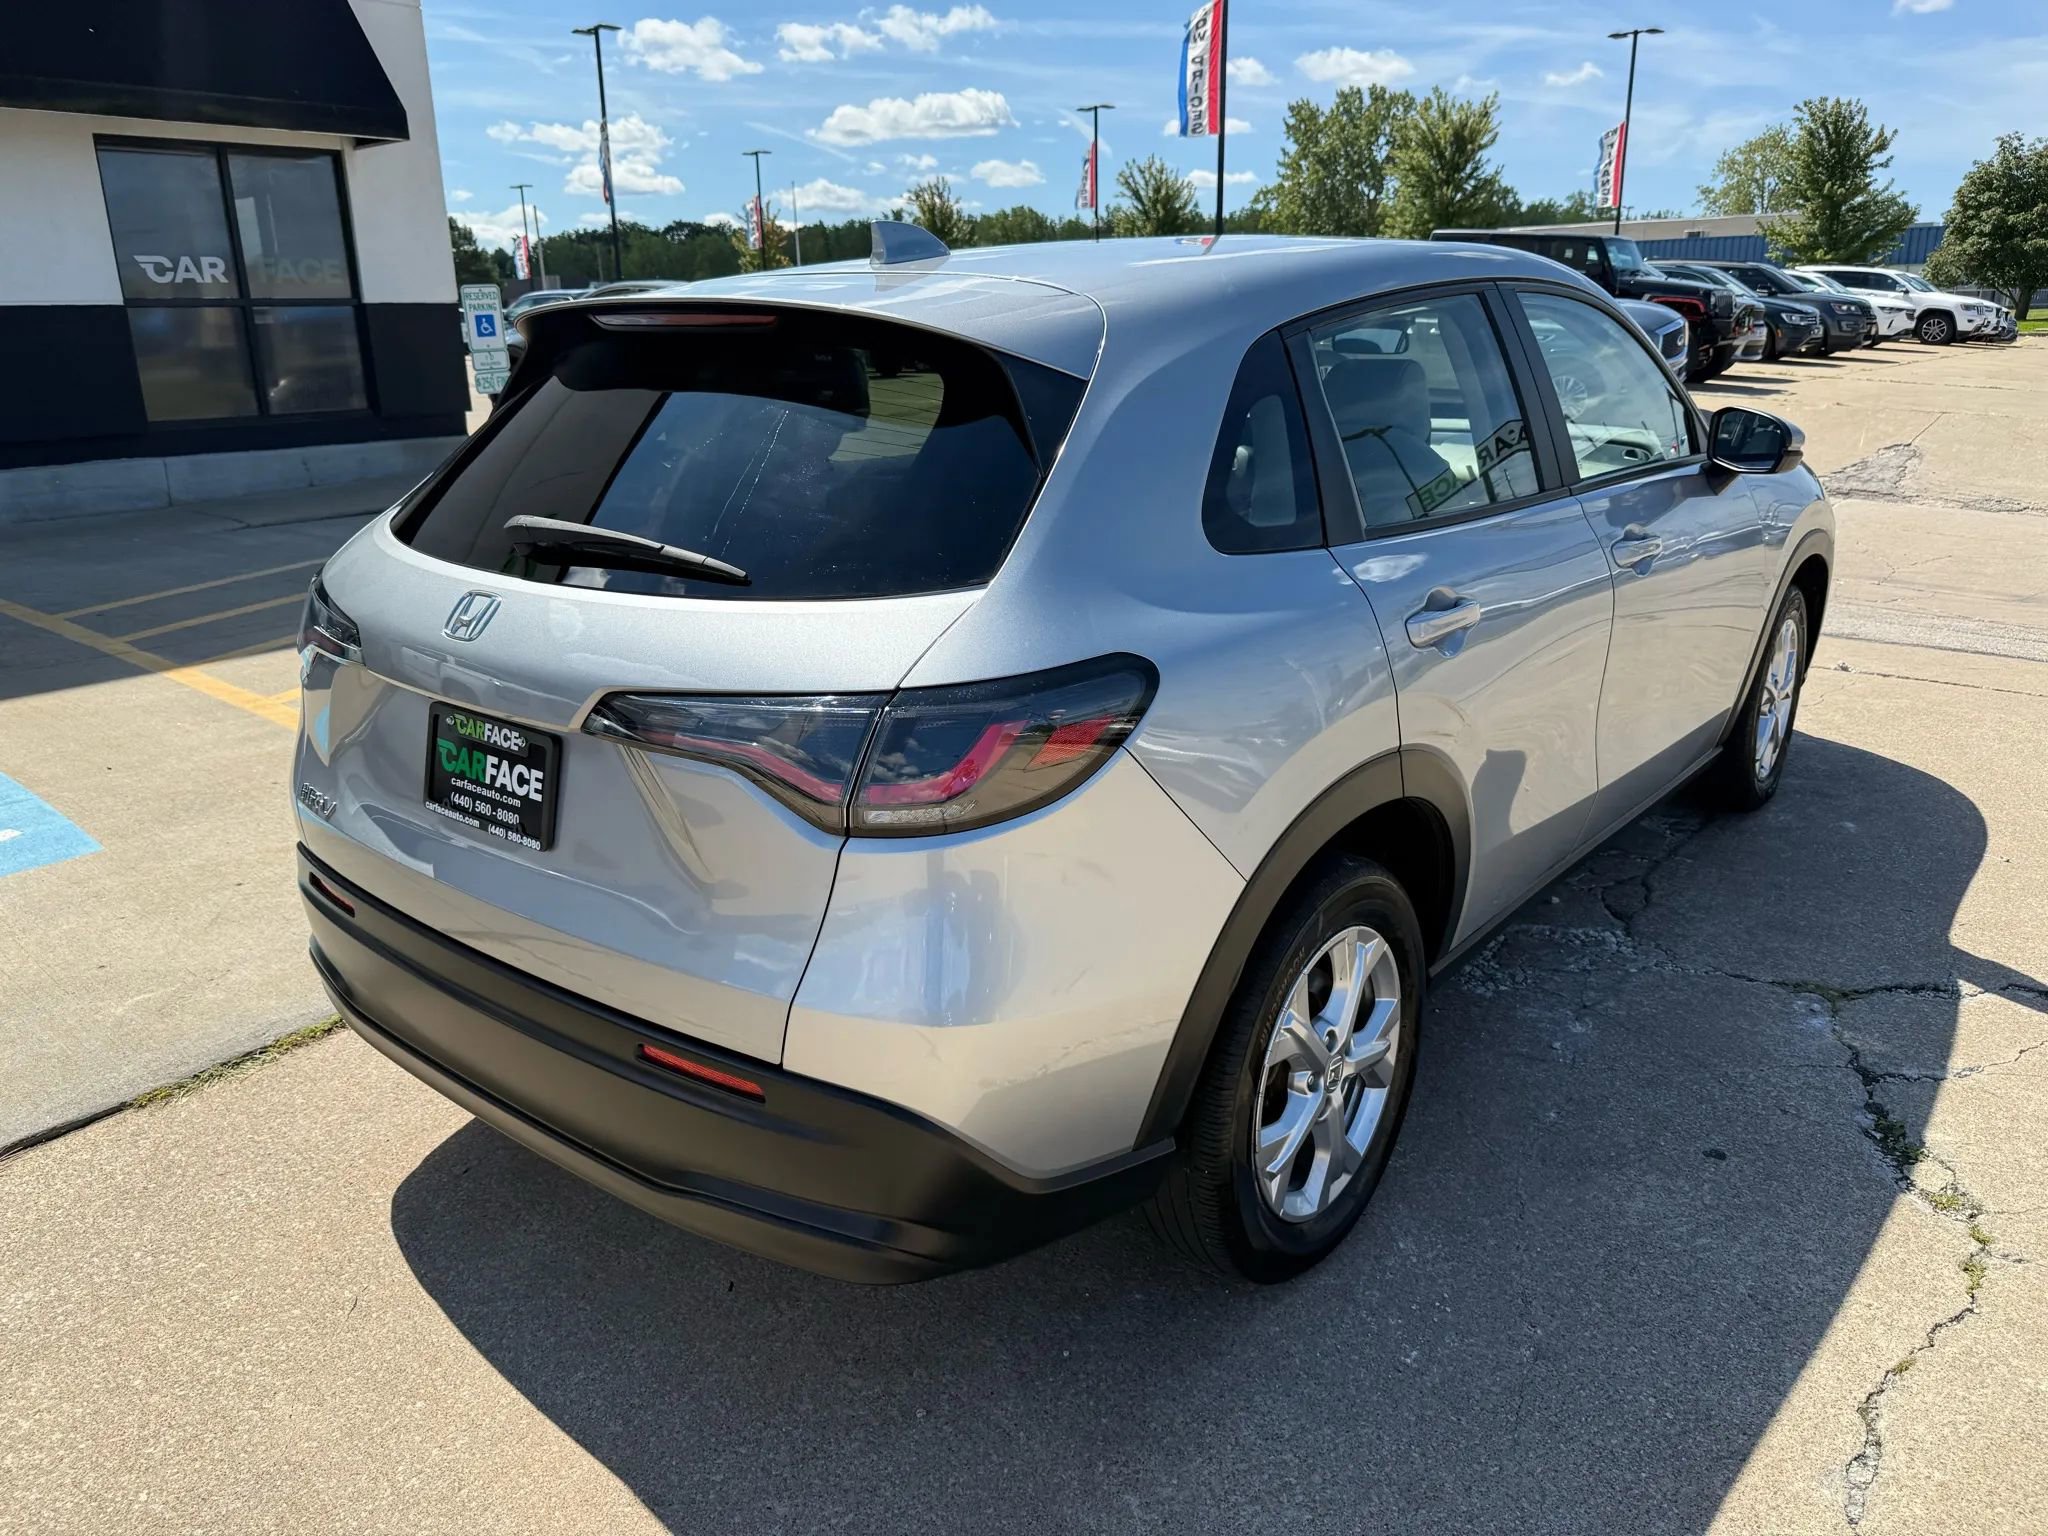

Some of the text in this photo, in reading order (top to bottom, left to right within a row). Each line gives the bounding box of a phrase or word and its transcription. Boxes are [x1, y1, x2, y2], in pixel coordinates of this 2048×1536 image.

[133, 255, 229, 284] CAR
[464, 291, 497, 301] RESERVED
[469, 303, 497, 312] PARKING
[437, 738, 544, 802] CARFACE
[450, 791, 473, 812] (440)
[451, 777, 521, 808] carfaceauto.com
[425, 801, 480, 828] carfaceauto.com
[488, 823, 506, 839] (440)
